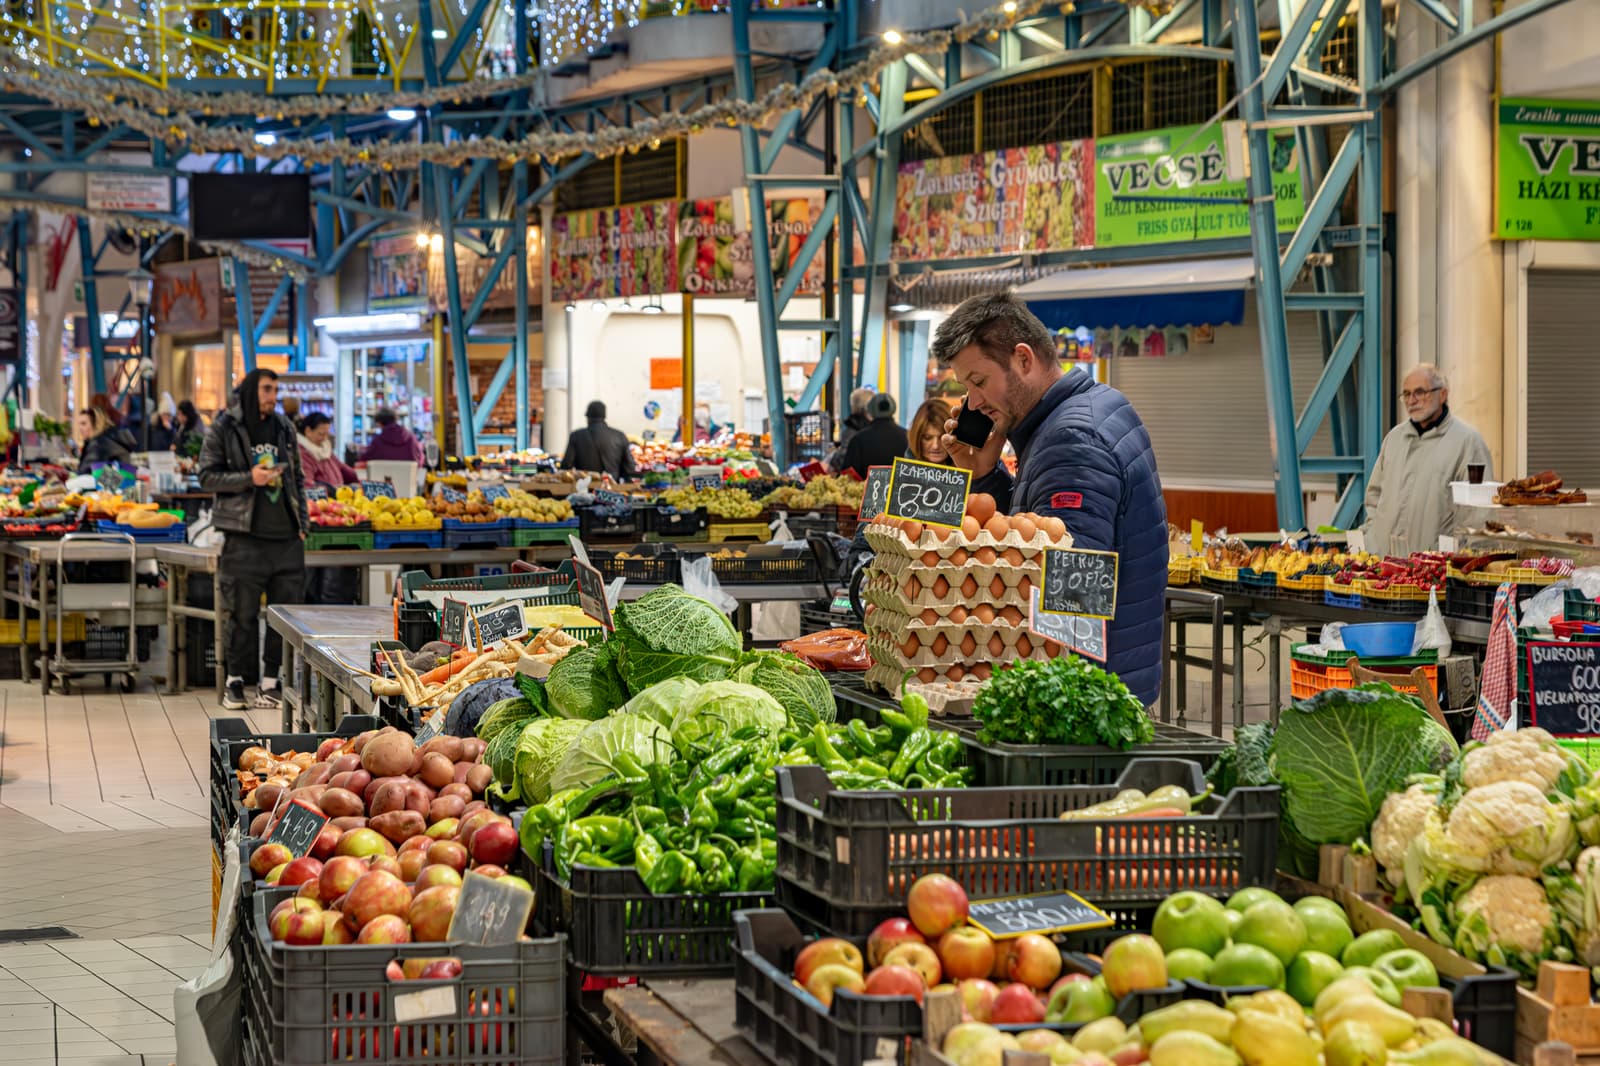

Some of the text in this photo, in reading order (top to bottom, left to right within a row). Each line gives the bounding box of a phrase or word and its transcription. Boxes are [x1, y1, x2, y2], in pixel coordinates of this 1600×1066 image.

[1518, 175, 1571, 200] HÁZI
[964, 195, 1019, 223] SZIGET
[1137, 217, 1168, 237] FRISS
